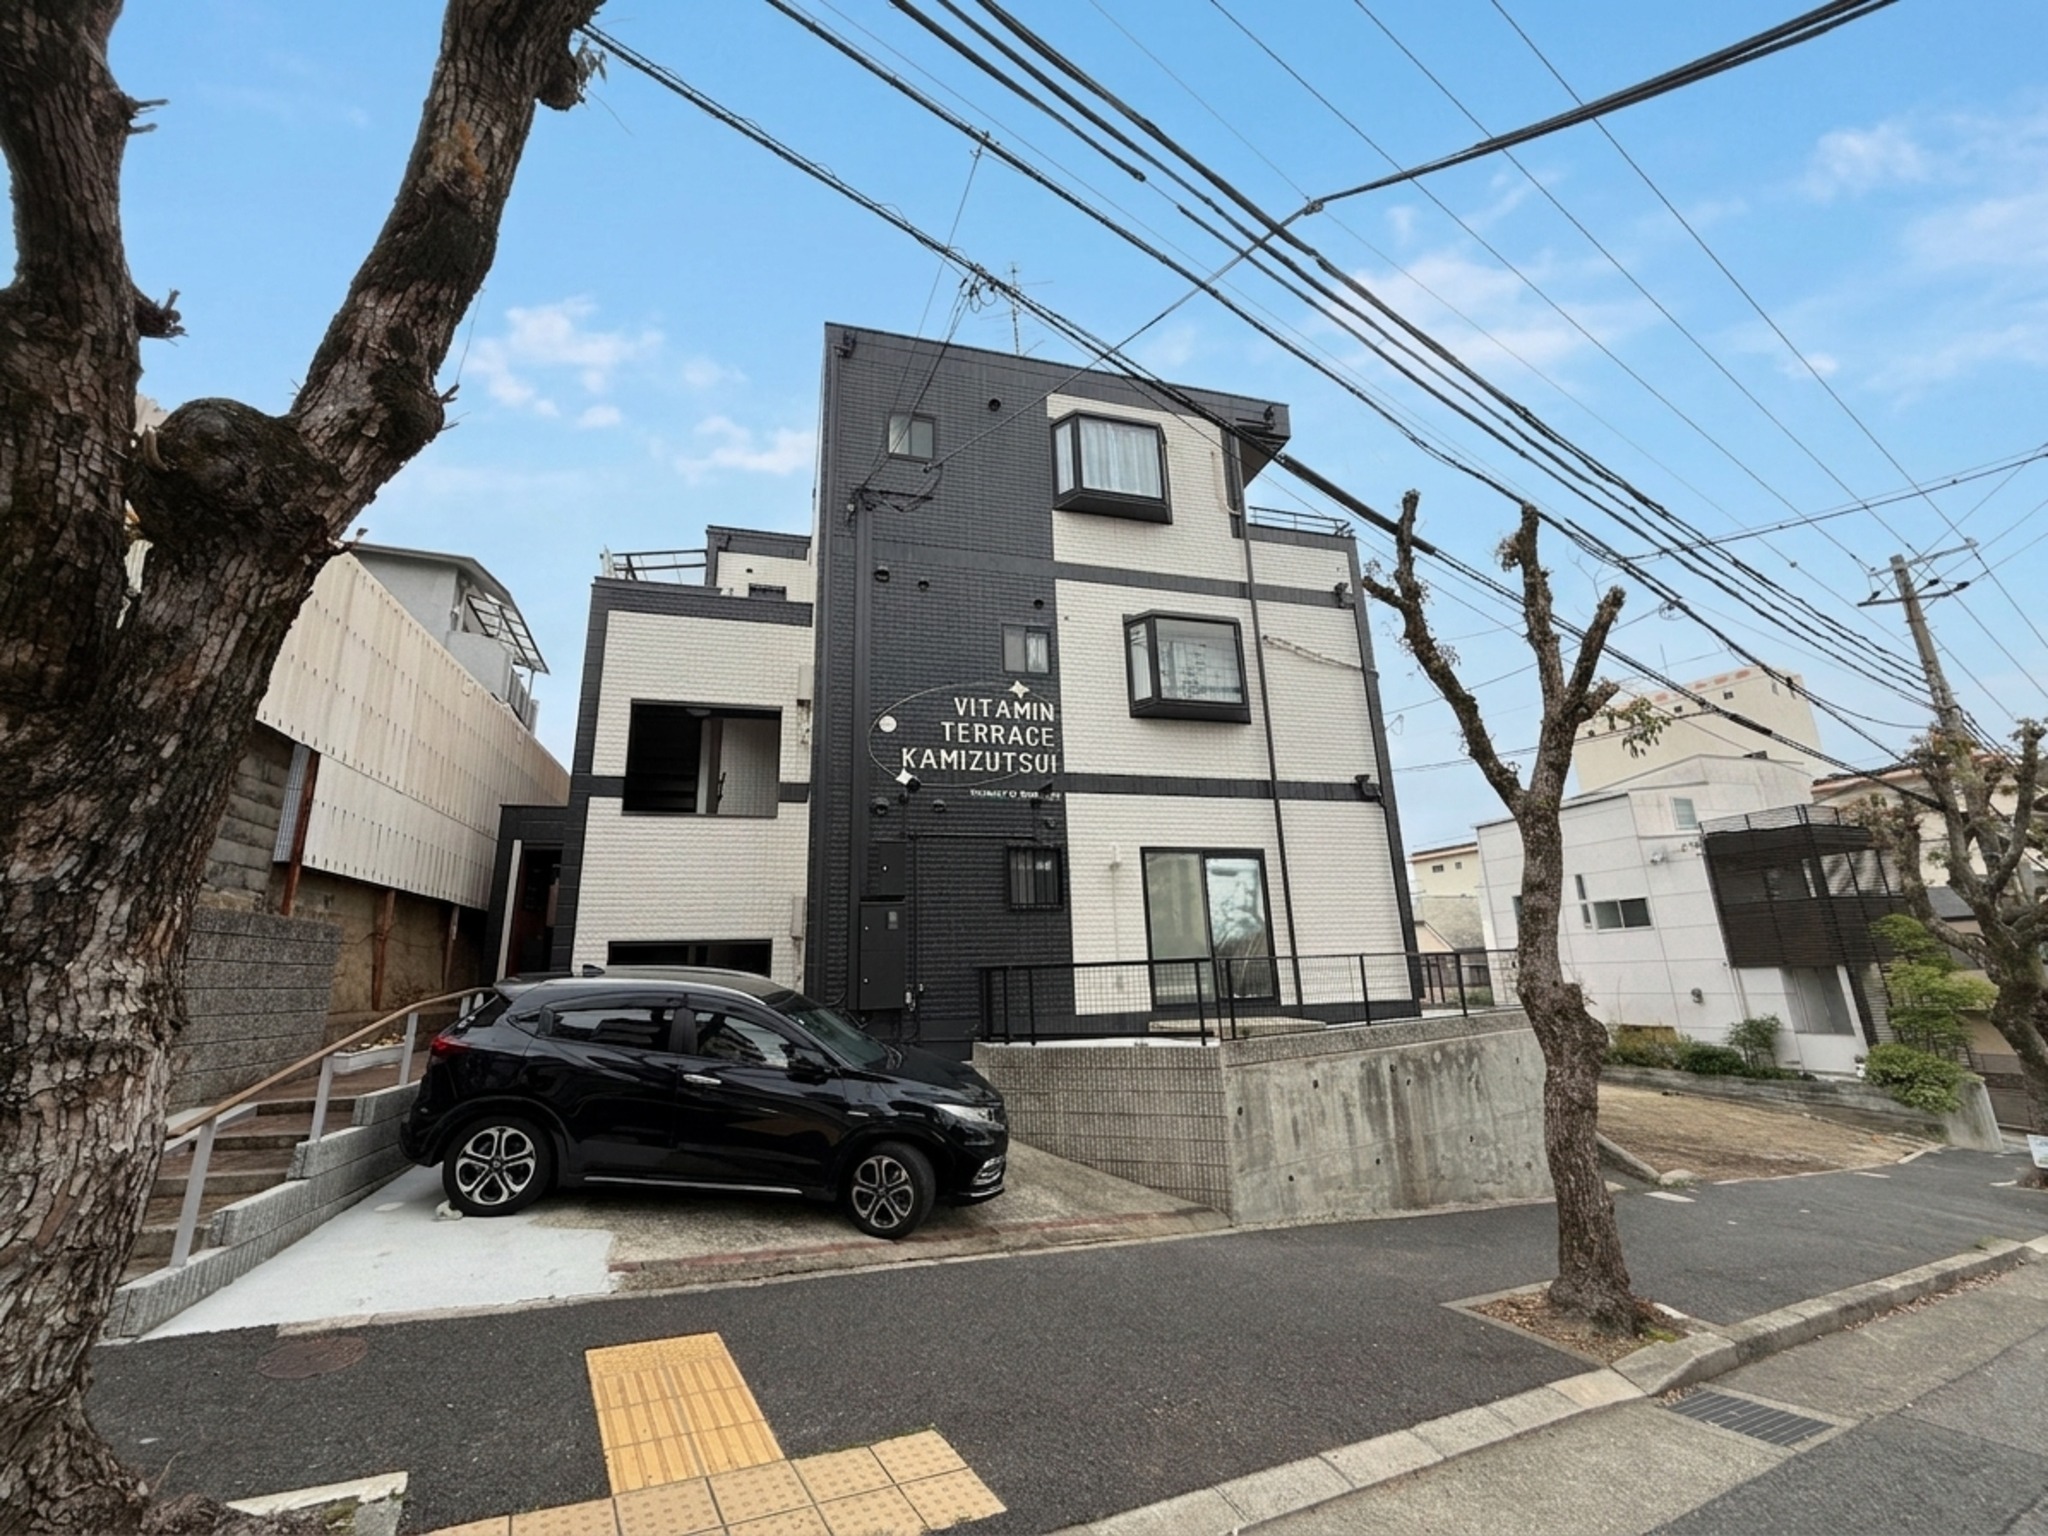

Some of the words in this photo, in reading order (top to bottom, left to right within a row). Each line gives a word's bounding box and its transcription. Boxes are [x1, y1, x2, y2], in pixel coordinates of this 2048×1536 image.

[953, 697, 1054, 722] VITAMIN
[940, 721, 1055, 747] TERRACE
[901, 747, 1057, 774] KAMIZUTSUI
